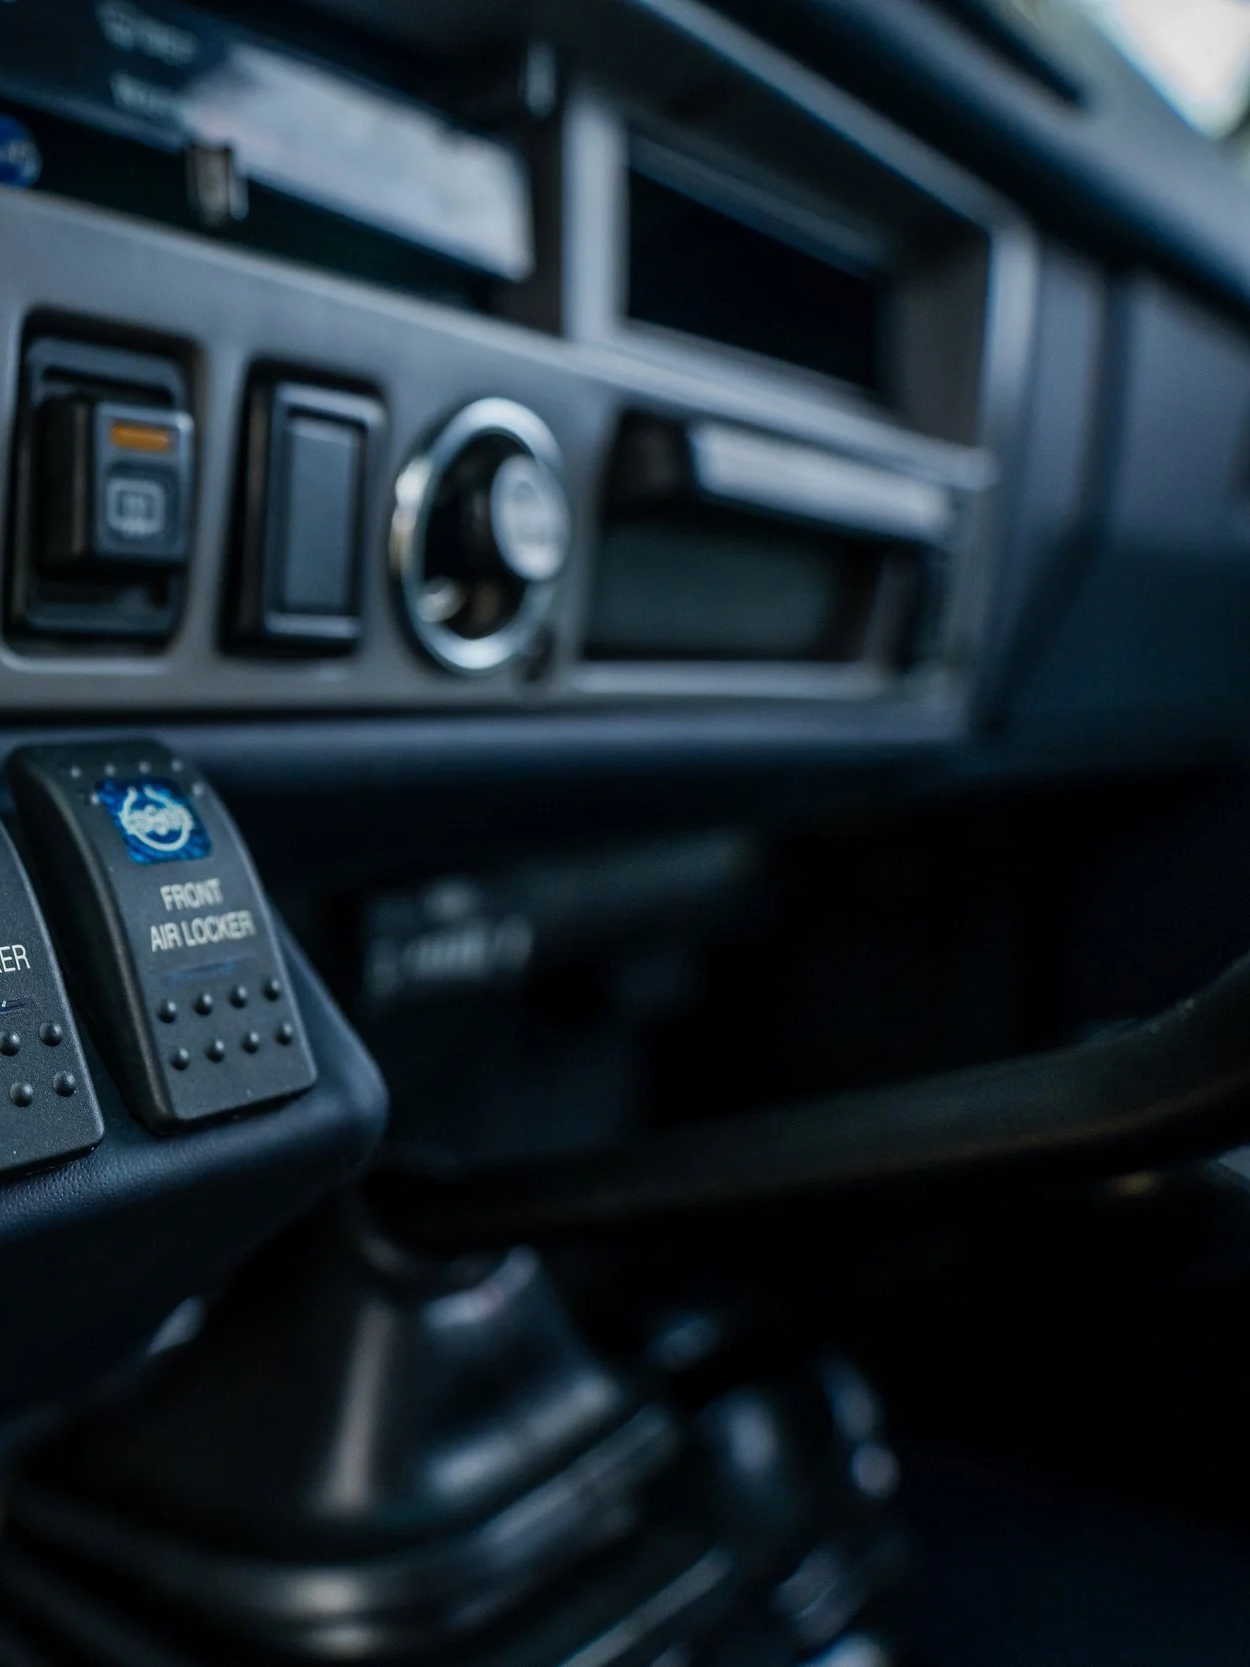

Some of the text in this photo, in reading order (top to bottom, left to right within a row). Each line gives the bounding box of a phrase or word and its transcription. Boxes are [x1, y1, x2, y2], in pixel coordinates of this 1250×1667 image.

[160, 878, 223, 912] FRONT
[151, 910, 257, 952] AIR LOCKER
